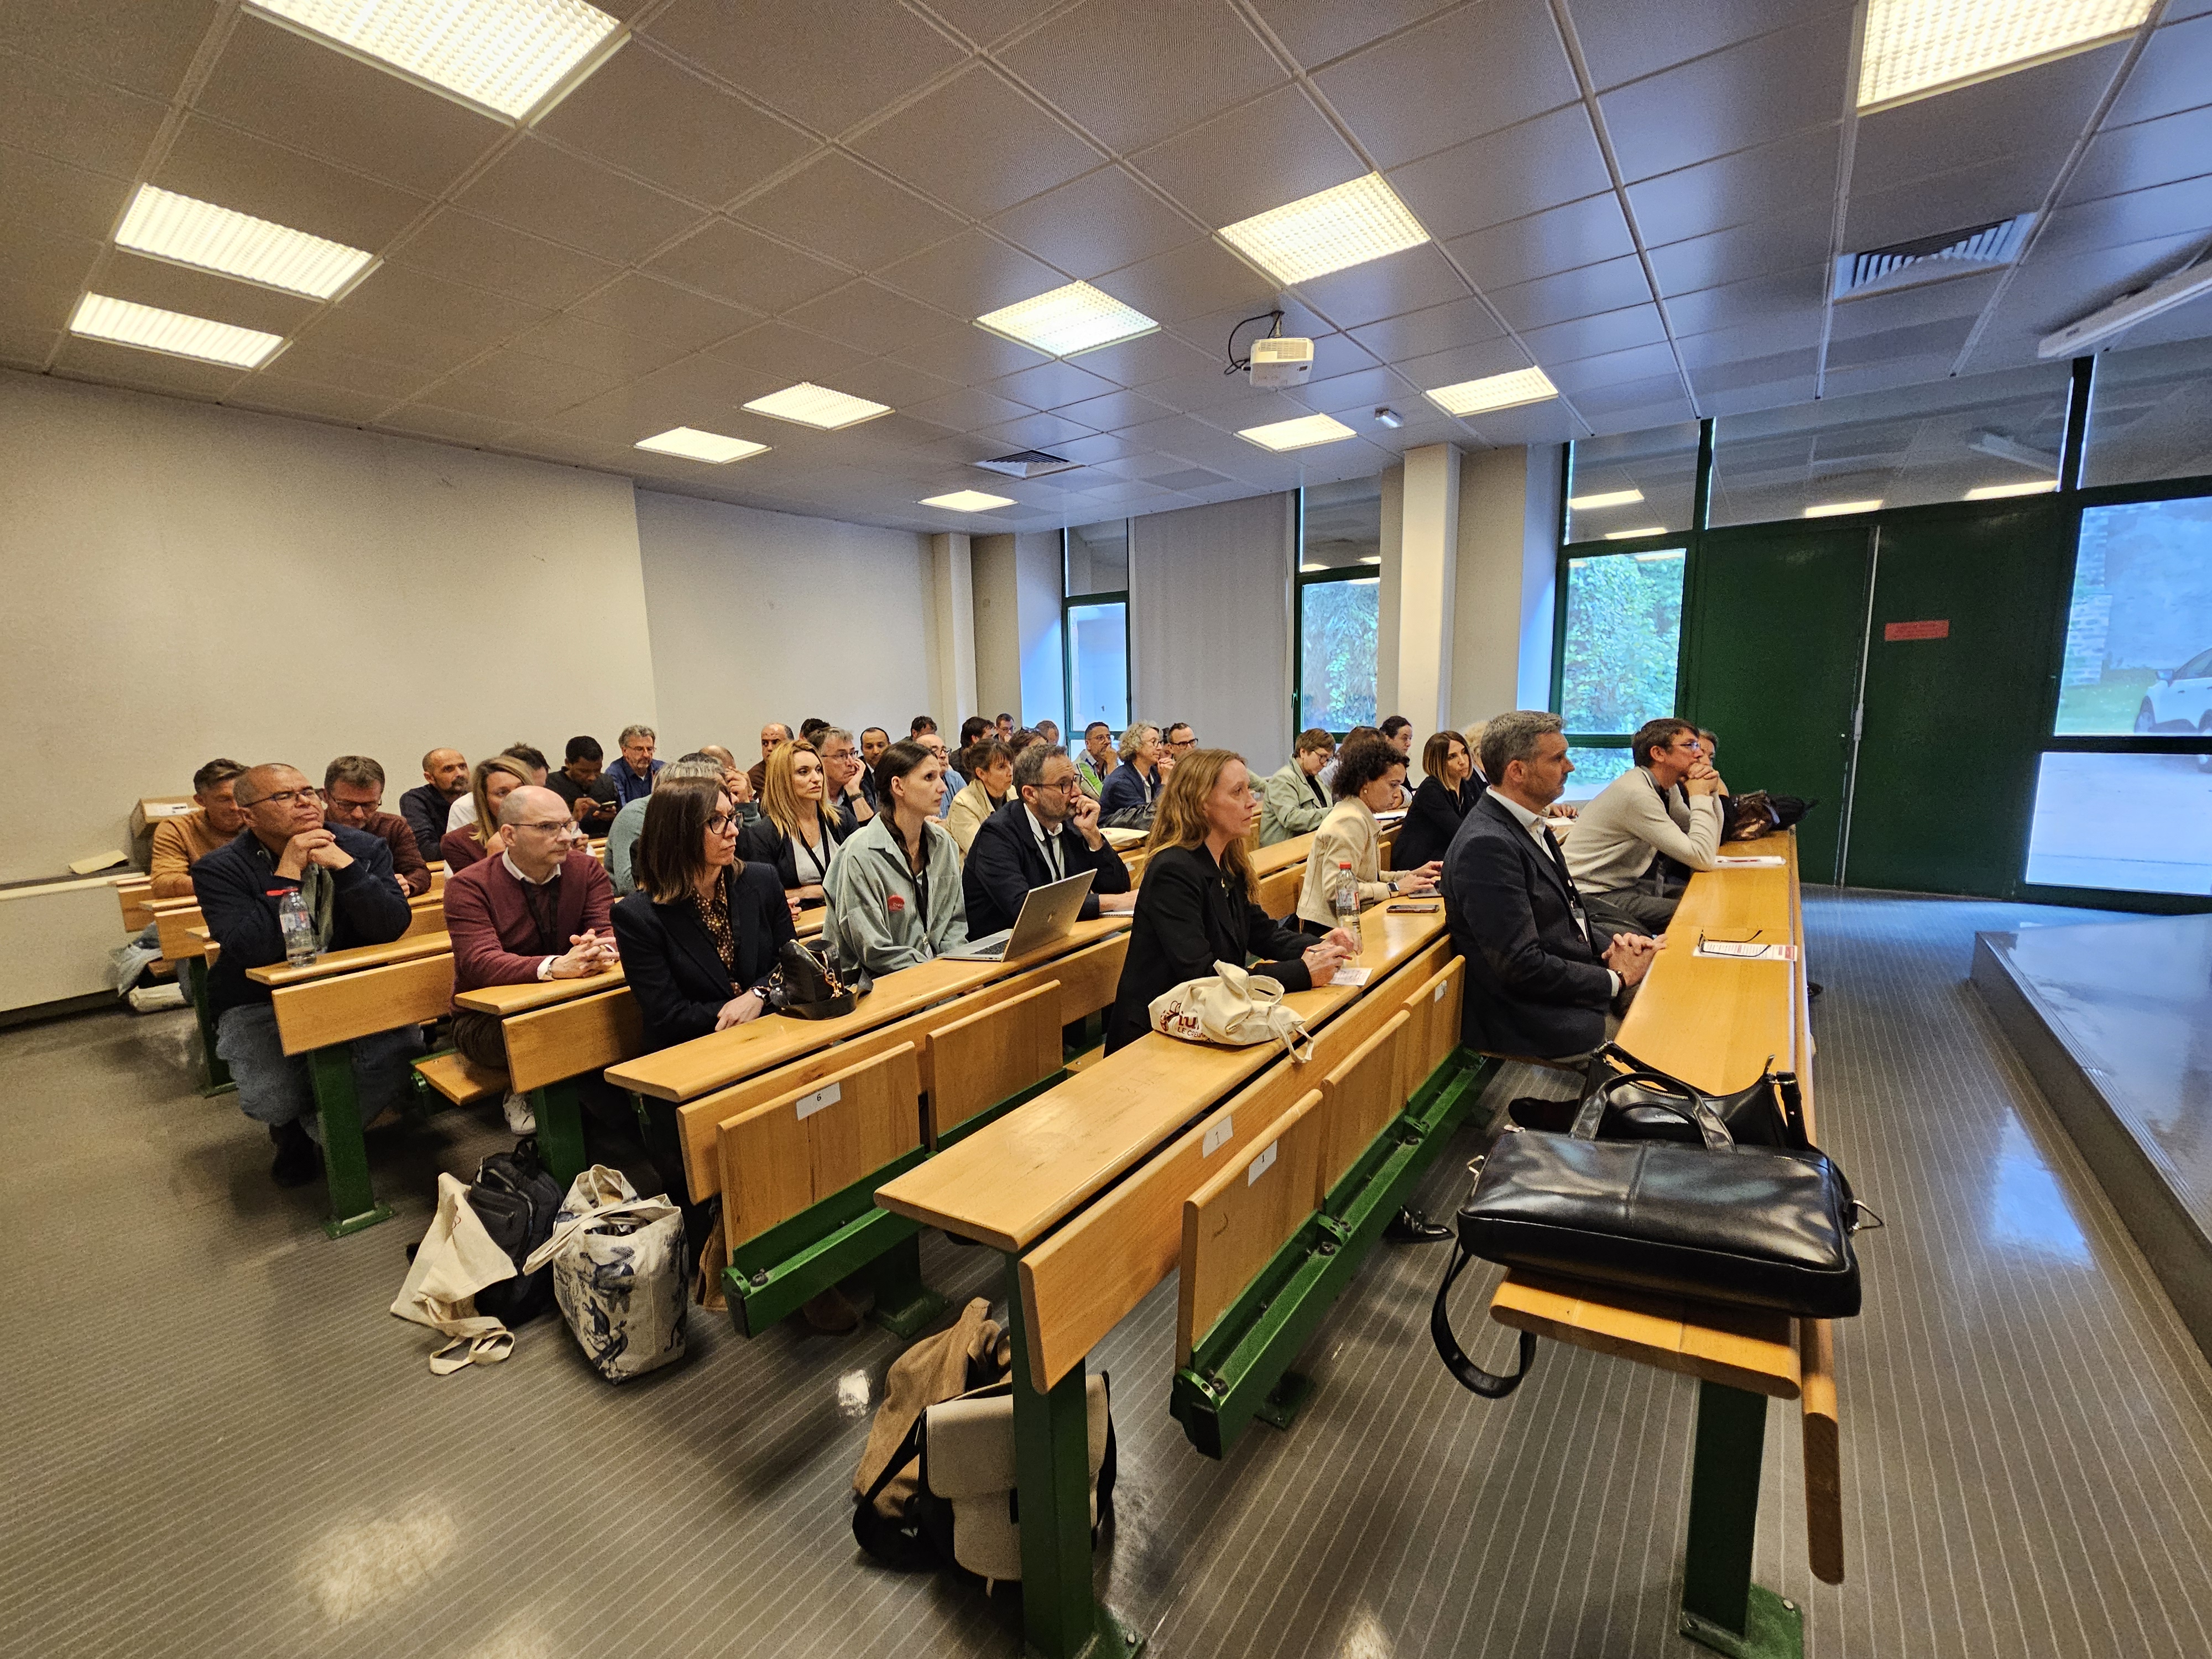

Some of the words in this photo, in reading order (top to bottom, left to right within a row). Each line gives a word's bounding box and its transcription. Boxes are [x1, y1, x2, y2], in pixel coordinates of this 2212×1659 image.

[1187, 1030, 1209, 1039] CREUS
[816, 1093, 822, 1102] 6
[1215, 1131, 1220, 1146] 1
